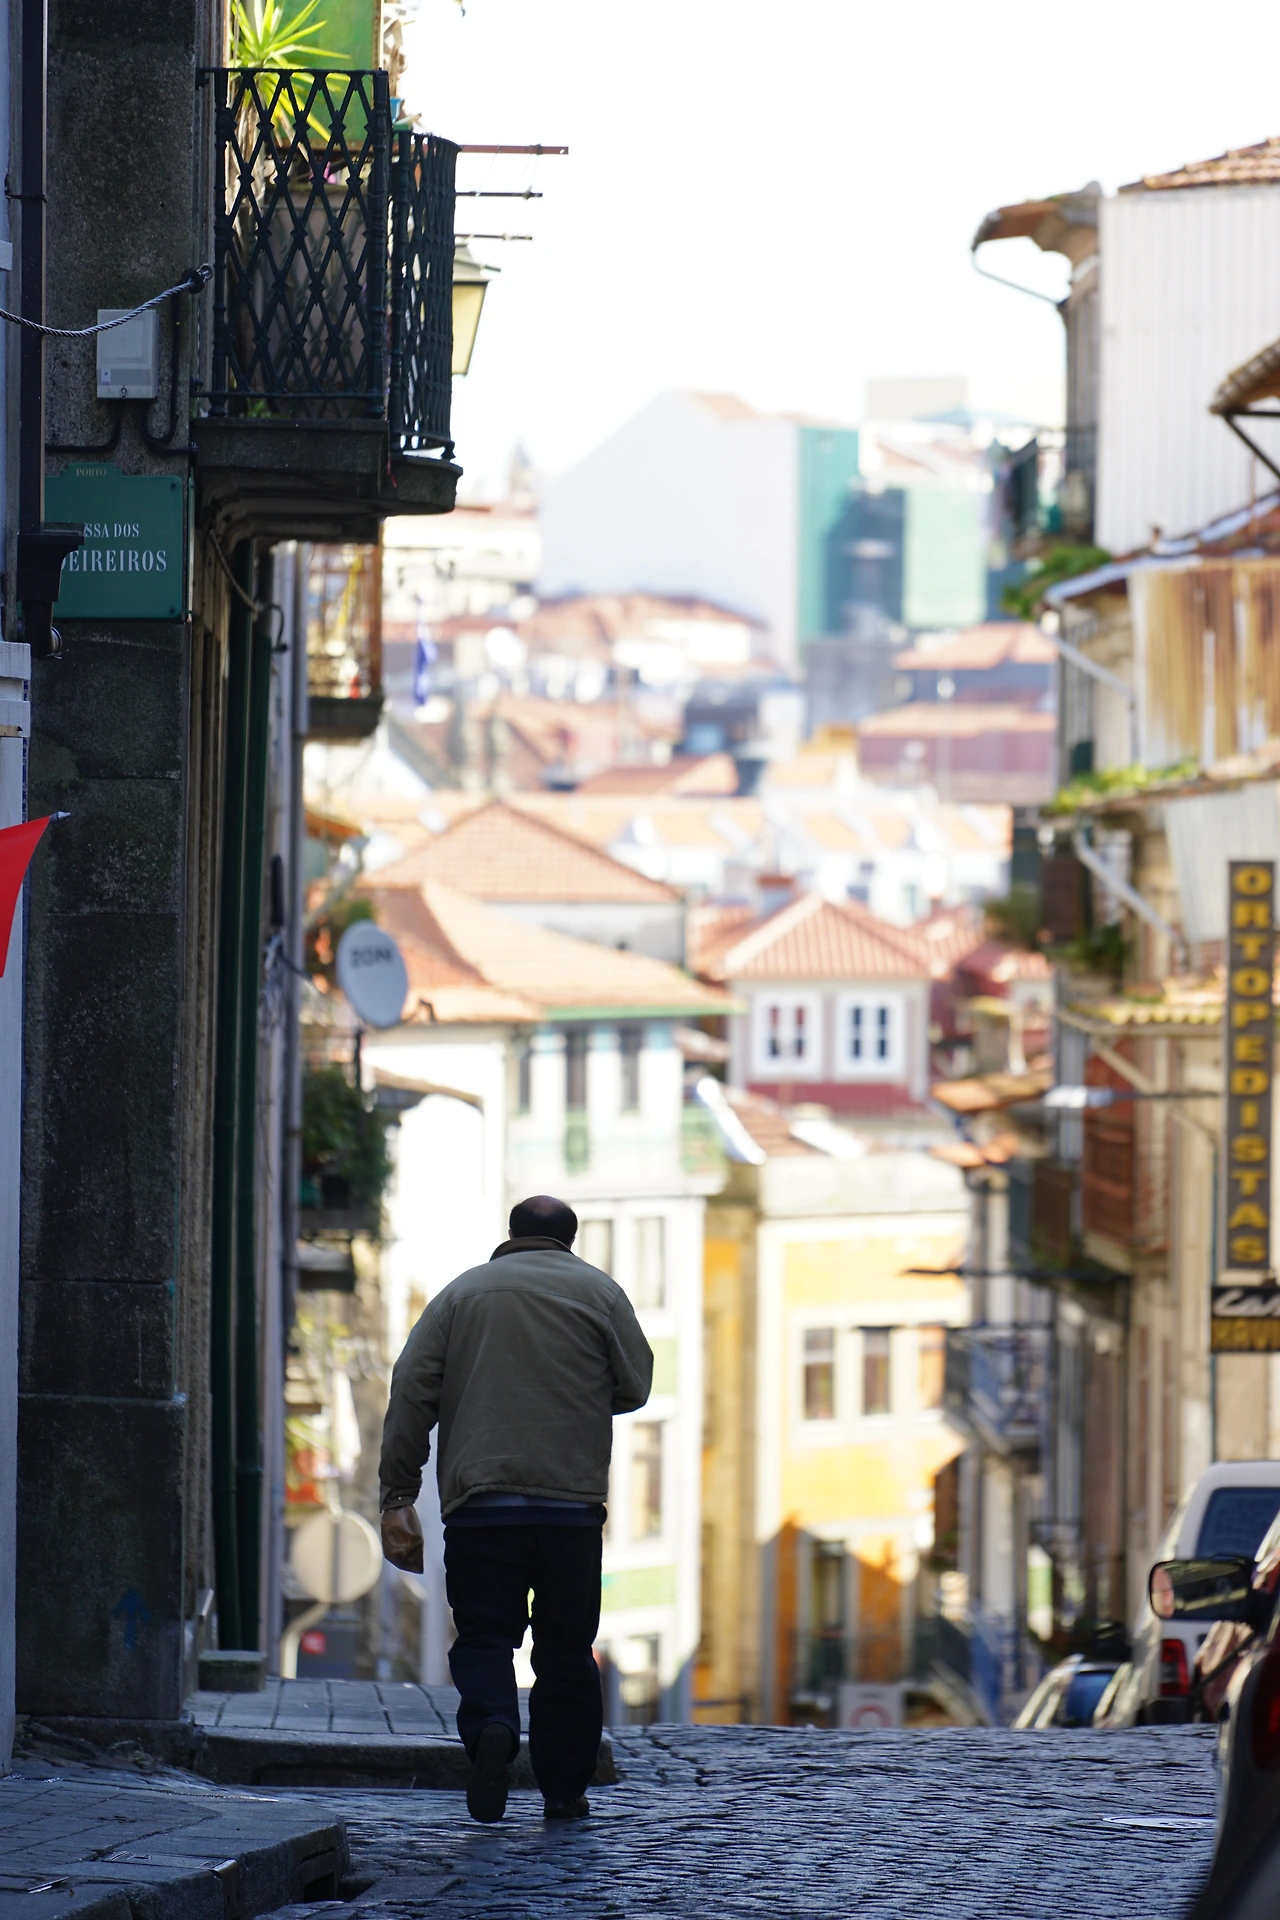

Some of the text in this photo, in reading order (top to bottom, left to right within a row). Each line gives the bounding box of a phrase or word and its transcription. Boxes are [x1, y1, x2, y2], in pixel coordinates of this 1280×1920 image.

[76, 468, 107, 476] PORTO
[114, 523, 140, 538] DOS
[61, 549, 167, 572] EIREIROS
[1229, 865, 1272, 1263] ORTOPEDISTAS
